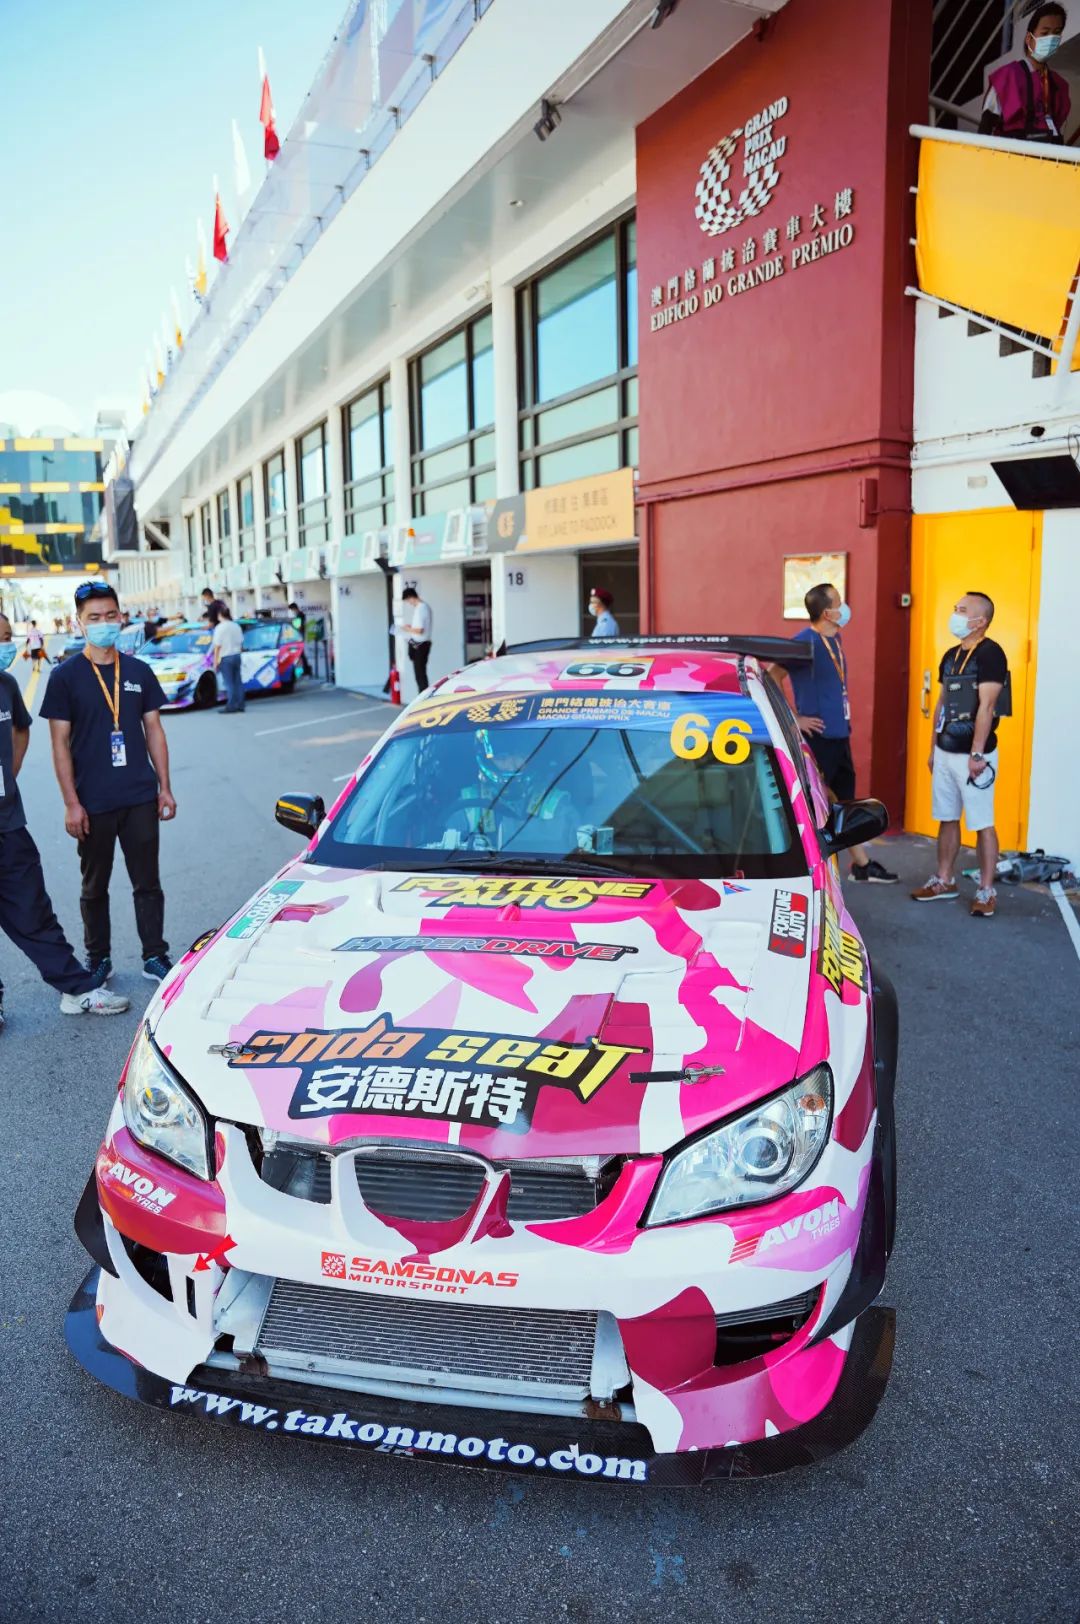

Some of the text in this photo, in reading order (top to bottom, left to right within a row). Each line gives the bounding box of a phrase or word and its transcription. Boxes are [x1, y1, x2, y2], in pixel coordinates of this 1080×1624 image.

[744, 96, 788, 139] GRAND
[743, 135, 786, 178] MACAU
[744, 124, 773, 158] PRIX
[703, 283, 723, 308] DO
[727, 256, 784, 297] GRANDE
[791, 223, 853, 269] PRÉMIO
[508, 572, 524, 586] 18
[588, 636, 729, 644] www.sport.gov.mo
[566, 662, 646, 677] 66
[670, 712, 753, 765] 66
[397, 876, 652, 898] FORTUNE
[435, 890, 593, 910] AUTO
[772, 888, 793, 938] FORTUNE
[788, 910, 806, 941] AUTO
[344, 936, 624, 960] HYPERDRIVE
[838, 928, 864, 988] AUTO
[300, 1065, 528, 1124] 安德斯特
[108, 1162, 176, 1208] AVON
[131, 1192, 163, 1215] TYRES
[758, 1197, 840, 1250] AVON
[811, 1217, 840, 1240] TYRES
[348, 1273, 468, 1295] MOTORSPORT
[350, 1256, 520, 1287] SAMSONAS
[169, 1384, 648, 1482] www.takonmoto.com
